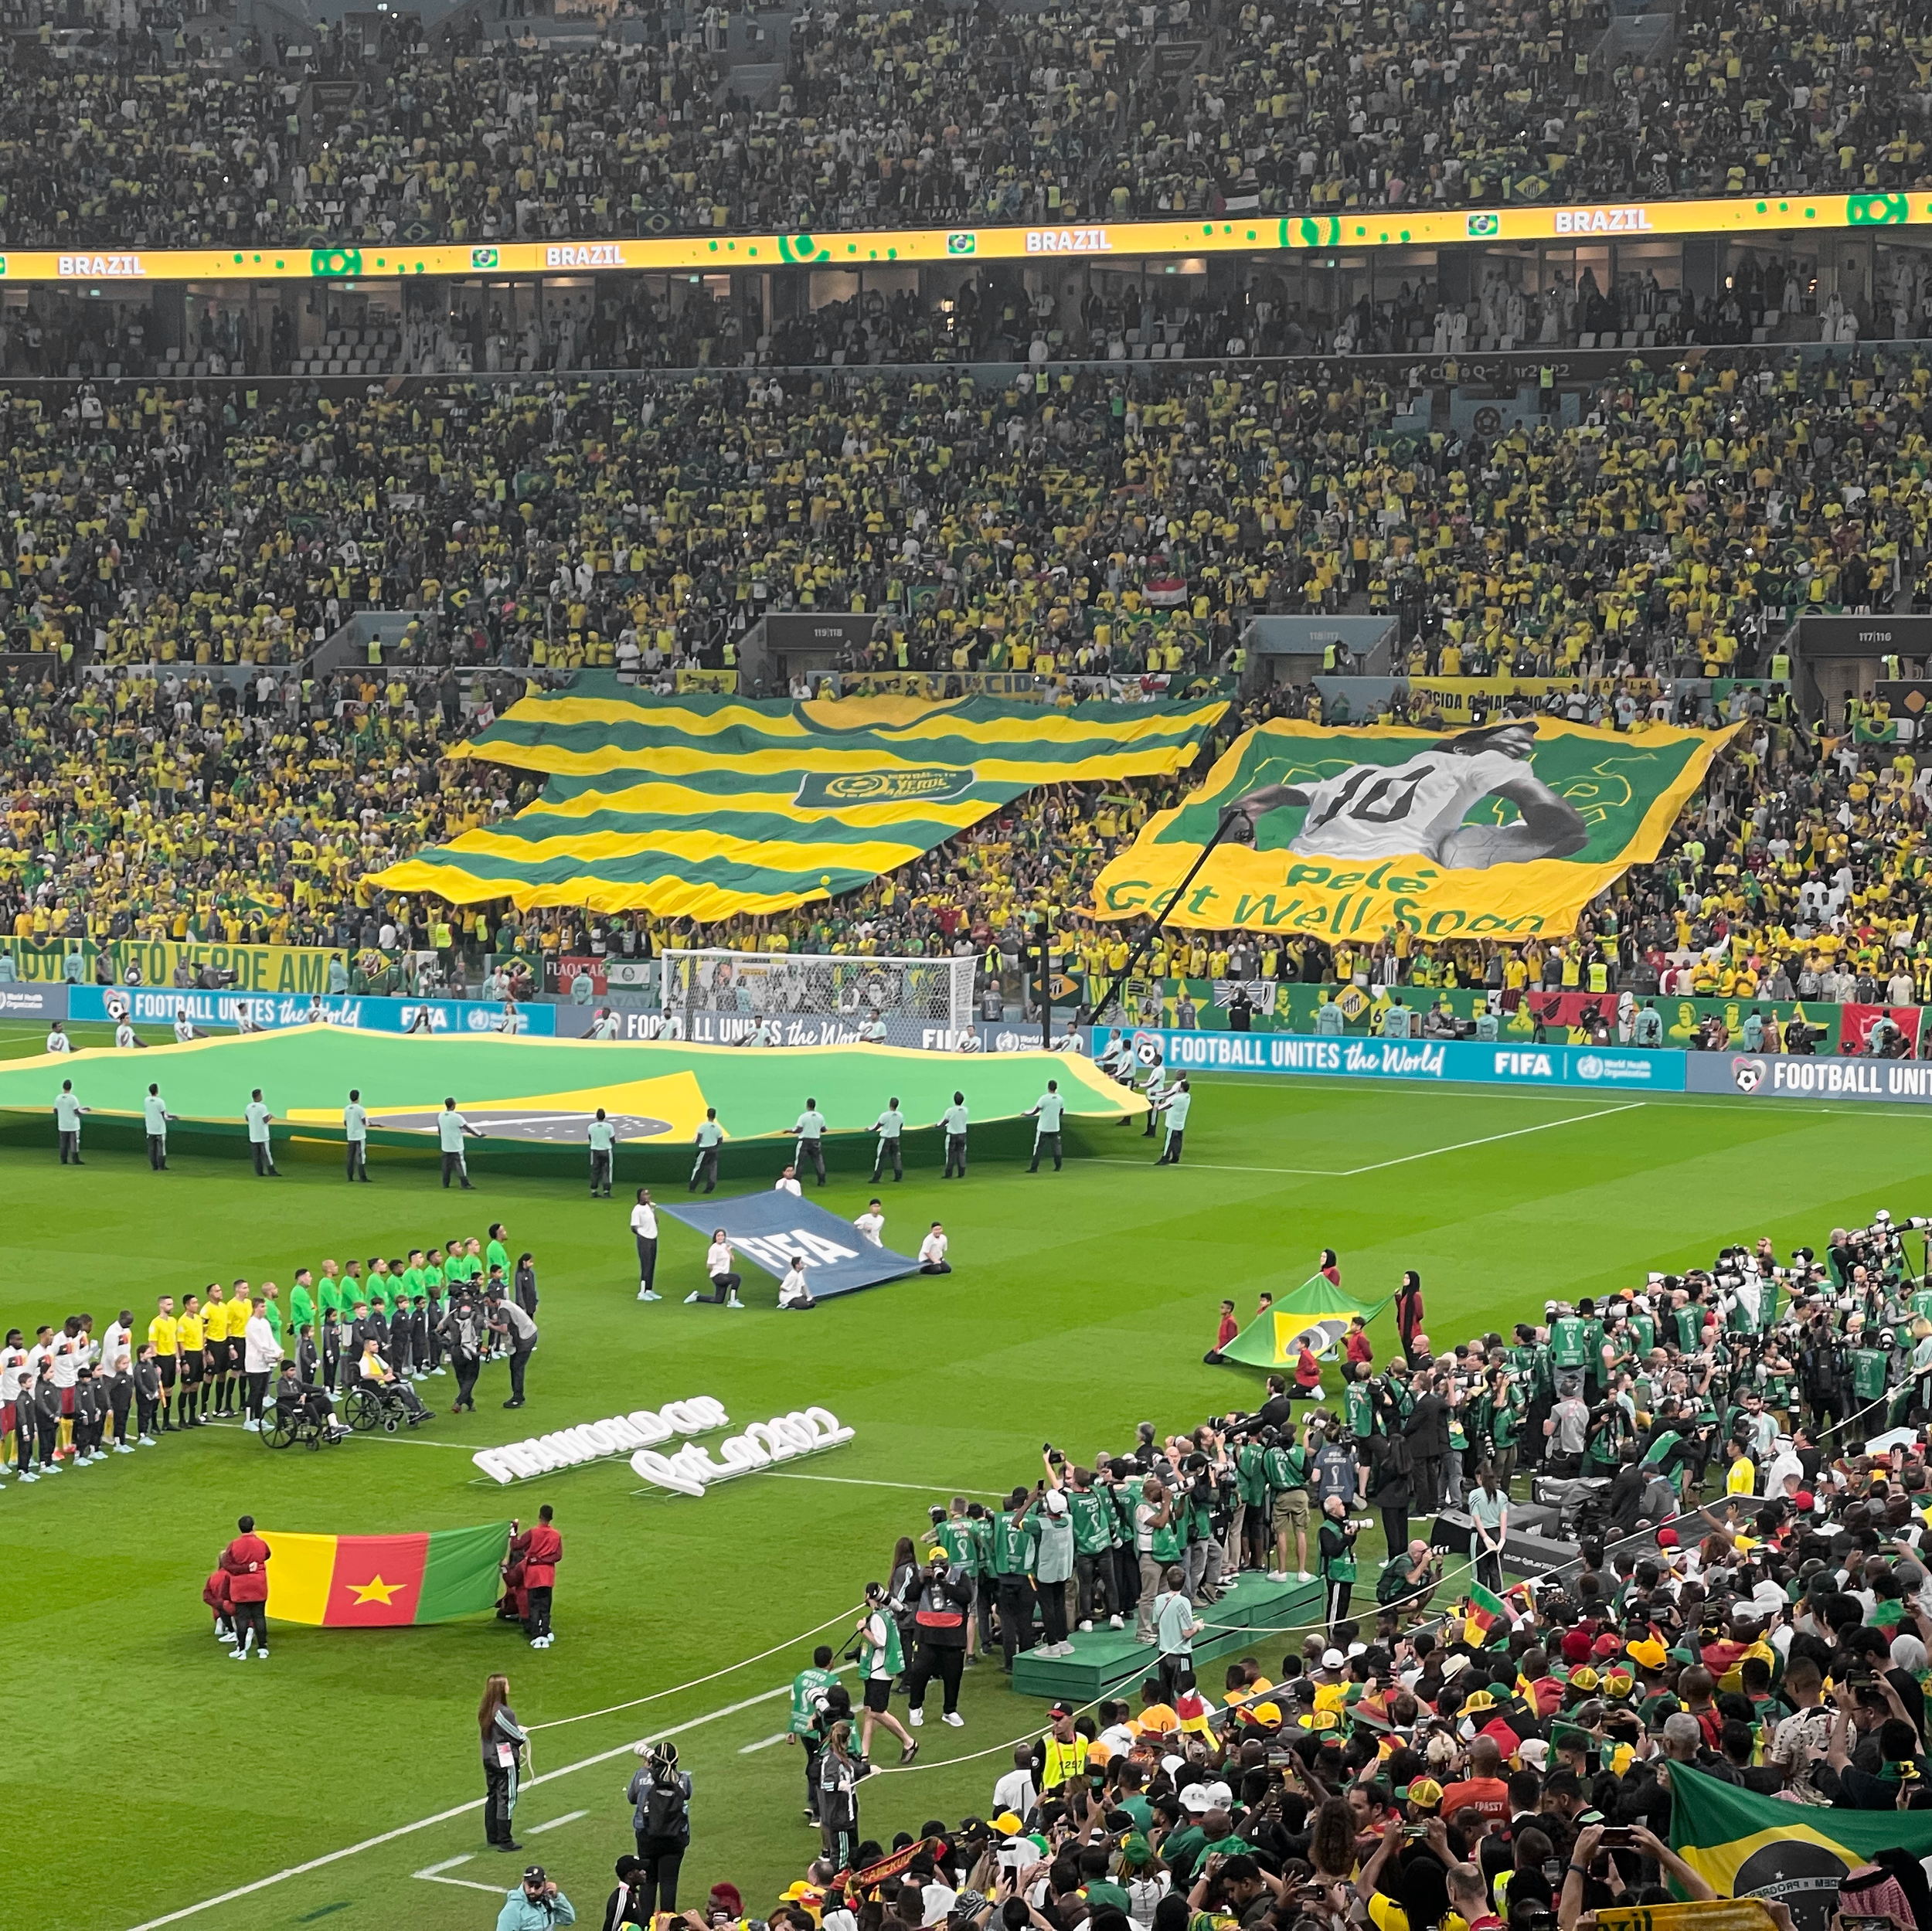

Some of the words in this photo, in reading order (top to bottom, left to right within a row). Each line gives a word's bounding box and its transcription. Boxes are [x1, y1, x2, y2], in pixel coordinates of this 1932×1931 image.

[1556, 209, 1652, 233] BRAZIL
[1026, 229, 1112, 252] BRAZIL
[58, 256, 146, 275] BRAZIL
[546, 245, 626, 267] BRAZIL
[1105, 880, 1219, 916] Get
[1236, 892, 1372, 935] Well
[1382, 896, 1545, 937] Soon
[277, 998, 309, 1023] the
[1171, 1037, 1265, 1066] FOOTBALL
[1272, 1040, 1339, 1069] UNITES
[1343, 1042, 1379, 1072] the
[1382, 1043, 1446, 1076] World
[1495, 1052, 1552, 1076] FIFA
[1604, 1059, 1626, 1069] World
[1628, 1060, 1651, 1070] Health
[1604, 1068, 1651, 1079] Organization
[1774, 1062, 1882, 1093] FOOTBALL
[727, 1229, 859, 1268] FIFA
[472, 1438, 555, 1484] FIFA
[539, 1410, 674, 1468] WORLD
[659, 1396, 730, 1435] CUP
